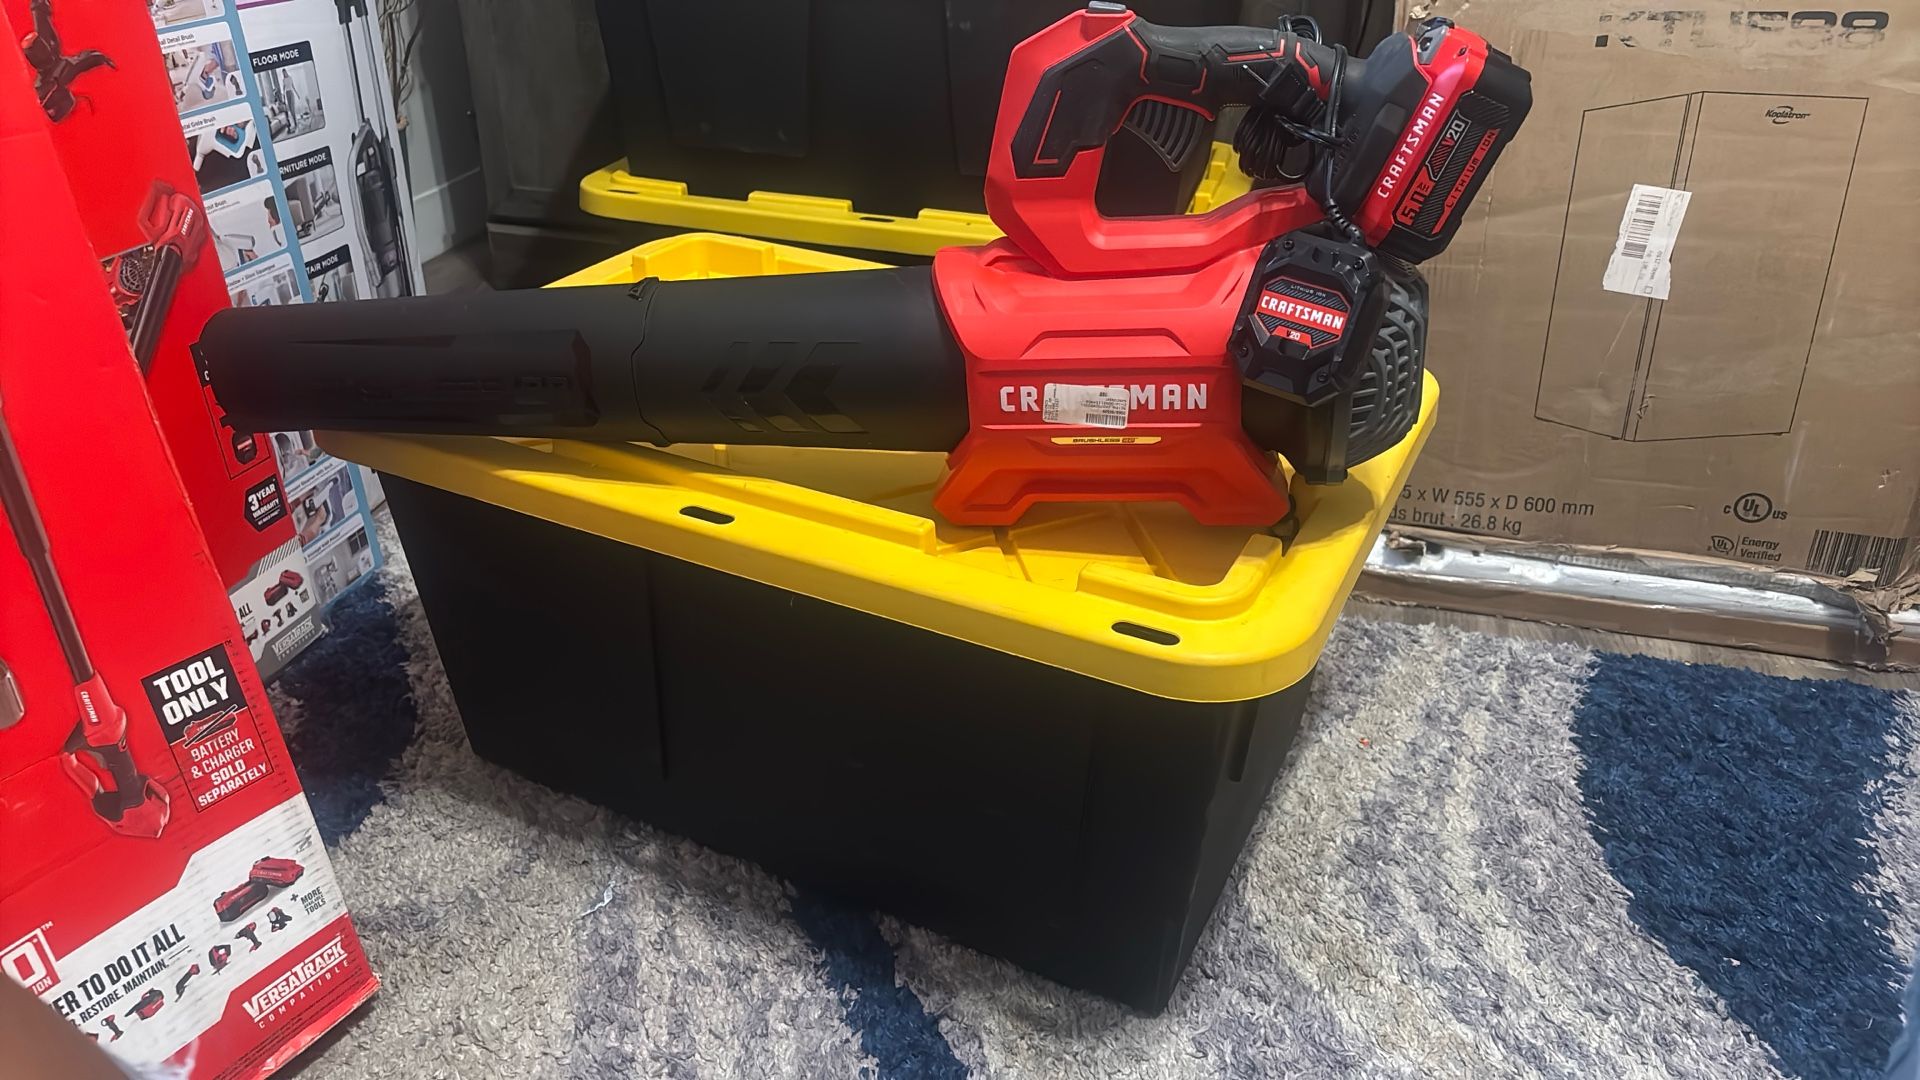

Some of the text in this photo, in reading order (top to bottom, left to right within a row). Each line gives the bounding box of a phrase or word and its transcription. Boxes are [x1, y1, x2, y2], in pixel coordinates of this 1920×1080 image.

[167, 35, 180, 44] Detail
[181, 33, 194, 41] Brush
[252, 49, 300, 67] FLOOR MODE
[1377, 92, 1445, 198] CRAFTSMAN
[1441, 119, 1466, 146] V20
[308, 152, 327, 164] MODE
[1445, 131, 1497, 208] LITHIUM ION
[322, 254, 339, 266] MODE
[1260, 295, 1344, 330] CRAFTSMAN
[1000, 383, 1208, 413] CRMAN
[248, 493, 260, 511] 3
[256, 483, 276, 501] YEAR
[1417, 489, 1427, 502] x
[1432, 487, 1450, 504] W
[1454, 490, 1486, 509] 555
[1490, 496, 1500, 509] x
[1506, 495, 1518, 510] D
[1524, 497, 1556, 513] 600
[1561, 503, 1595, 517] mm
[1742, 498, 1761, 519] UL
[1771, 510, 1789, 521] us
[1413, 507, 1446, 525] brut
[1460, 513, 1497, 531] 26.8
[1502, 517, 1523, 536] kg
[1740, 548, 1783, 562] Verified
[1741, 536, 1780, 551] Energy
[238, 603, 253, 620] ALL
[152, 655, 225, 700] TOOL
[162, 676, 229, 726] ONLY
[190, 727, 240, 762] BATTERY
[191, 738, 255, 779] & CHARGER
[198, 762, 268, 807] SEPARATELY
[210, 759, 246, 786] SOLD
[300, 886, 323, 904] MORE
[305, 898, 327, 915] TOOLS
[77, 973, 107, 1002] TO
[104, 955, 130, 986] DO
[131, 942, 152, 968] IT
[152, 923, 186, 956] ALL
[80, 990, 124, 1023] RESTORE.
[122, 959, 170, 995] MAINTAIN.
[241, 935, 348, 1023] VERSATRACK
[258, 960, 349, 1029] COMPATIBLE
